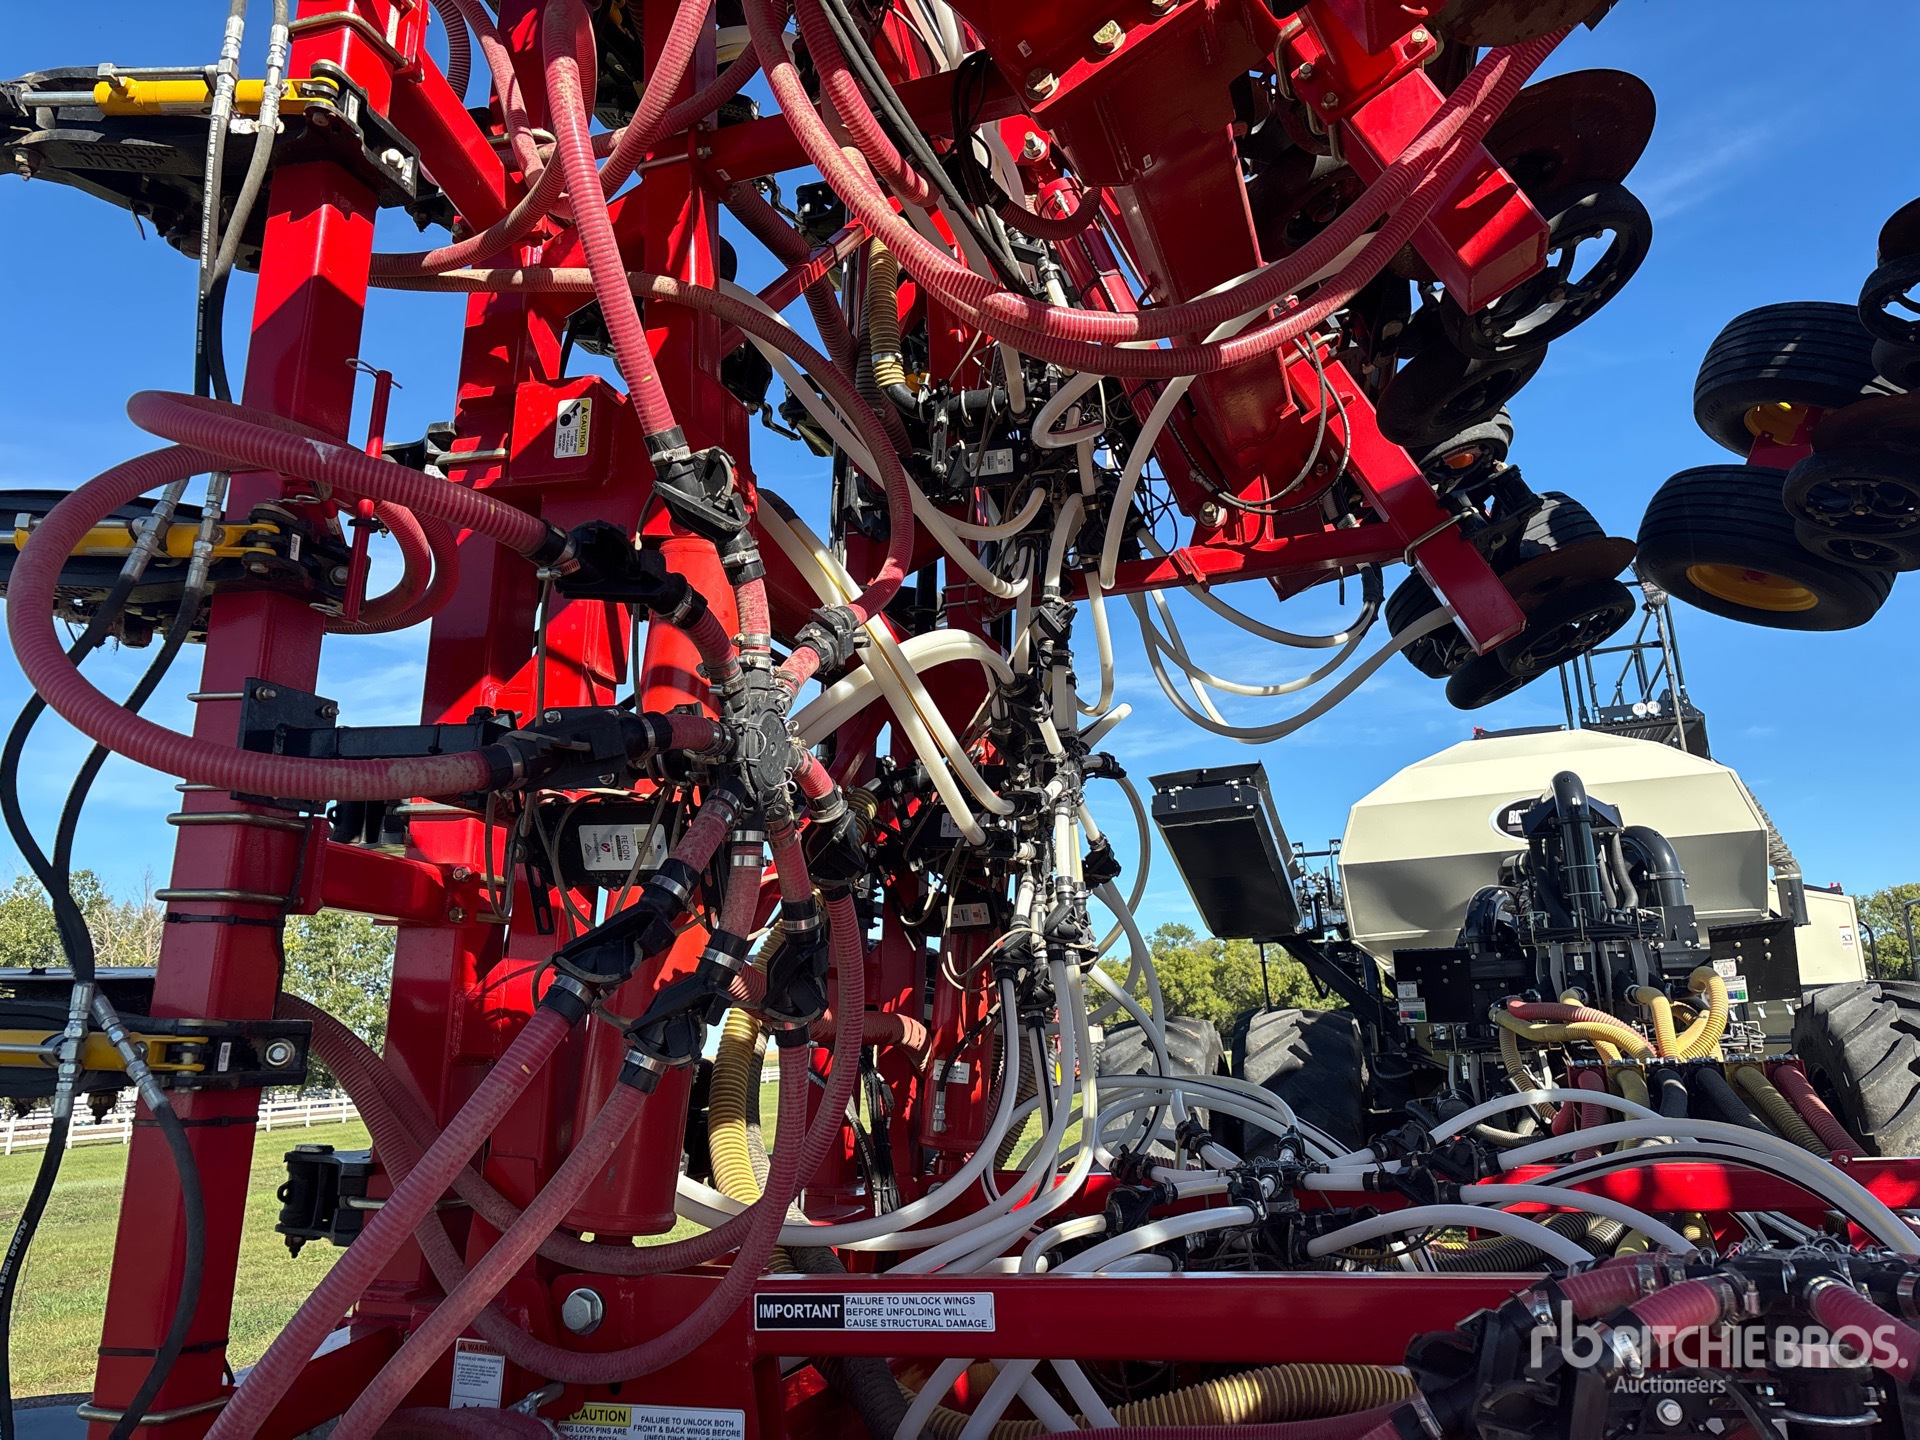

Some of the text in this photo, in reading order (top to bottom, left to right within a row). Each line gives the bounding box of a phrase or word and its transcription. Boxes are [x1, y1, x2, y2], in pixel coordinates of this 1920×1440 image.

[621, 835, 630, 860] RECON
[9, 1220, 28, 1257] PULSAR
[845, 1297, 976, 1305] FAILURE TO UNLOCK WINGS
[759, 1304, 841, 1319] IMPORTANT
[845, 1308, 967, 1317] BEFORE UNFOLDING WILL
[845, 1319, 991, 1328] CAUSE STRUCTURAL DAMAGE.
[468, 1343, 498, 1354] WARNIN
[571, 1409, 626, 1422] CAUTION
[641, 1415, 734, 1428] FAILURE TO UNLOCK BOTH
[575, 1425, 594, 1434] LOCK
[595, 1426, 612, 1435] PINS
[612, 1427, 627, 1435] ARE
[633, 1424, 657, 1433] FRONT
[665, 1426, 685, 1434] BACK
[686, 1427, 711, 1436] WINGS
[712, 1428, 741, 1437] BEFORE
